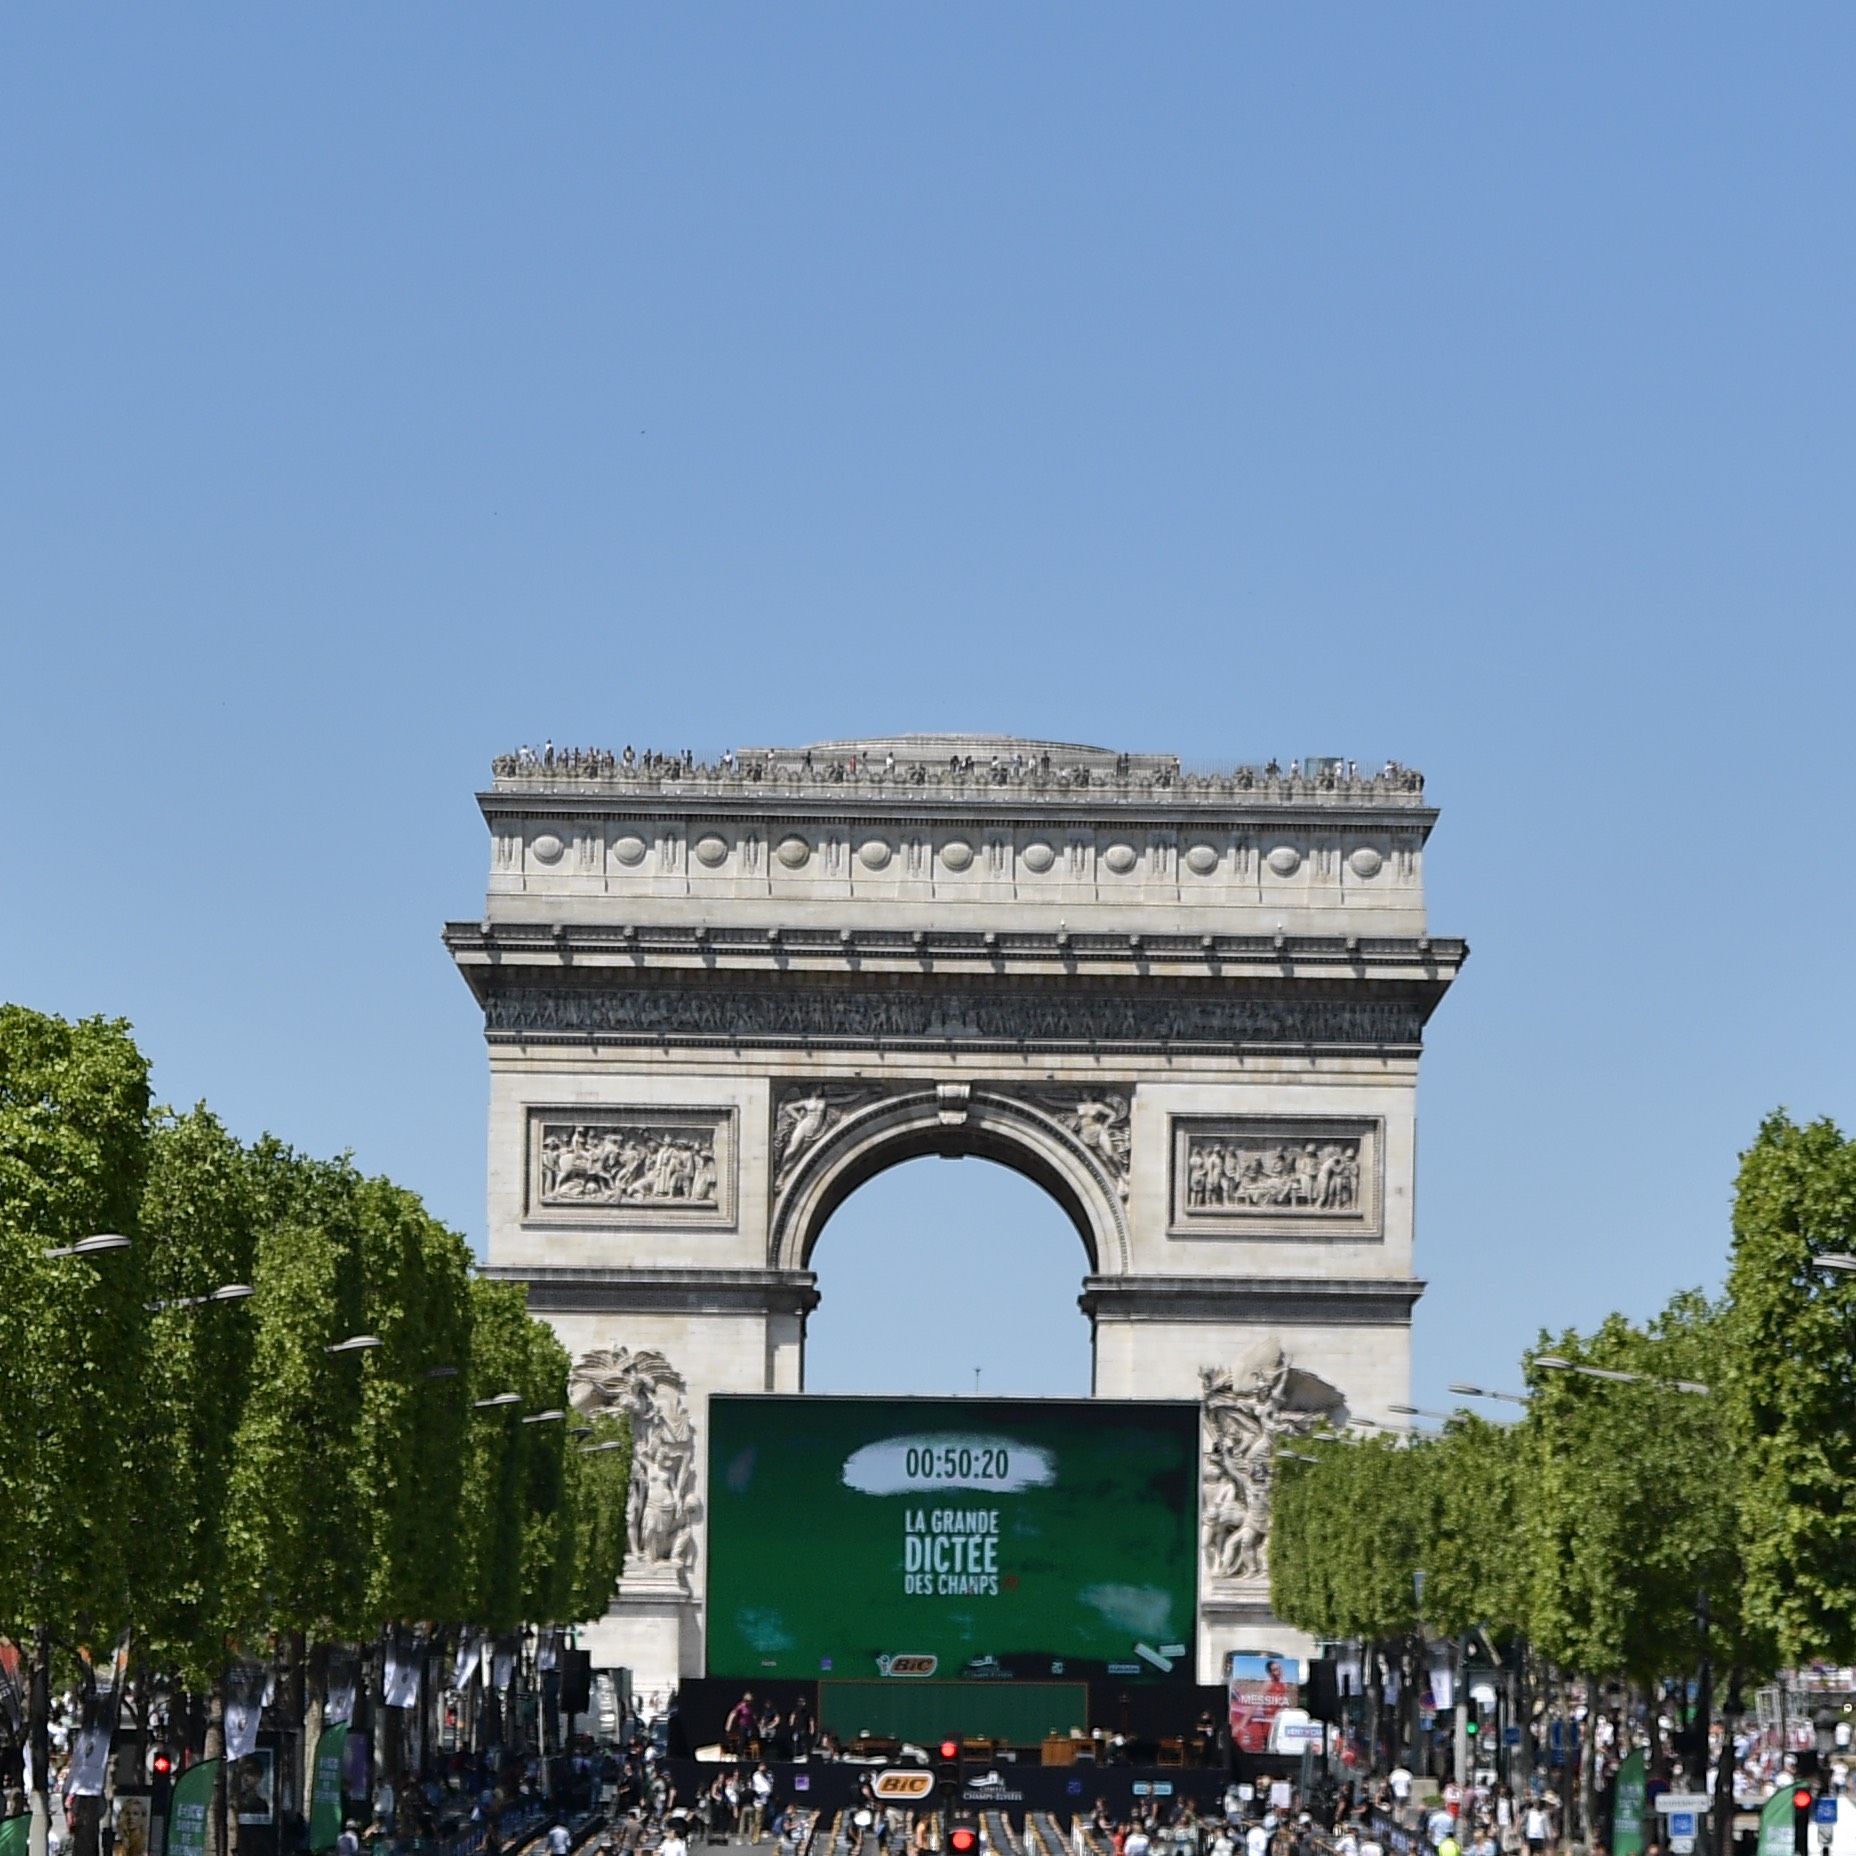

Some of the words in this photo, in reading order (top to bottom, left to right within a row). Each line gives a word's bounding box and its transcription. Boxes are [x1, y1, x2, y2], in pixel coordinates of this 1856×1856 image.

[906, 1449, 1008, 1479] 00:50:20
[905, 1509, 926, 1533] LA
[931, 1509, 999, 1533] GRANDE
[905, 1535, 998, 1574] DICTÉE
[905, 1575, 933, 1595] DES
[938, 1575, 998, 1595] CHAMPS
